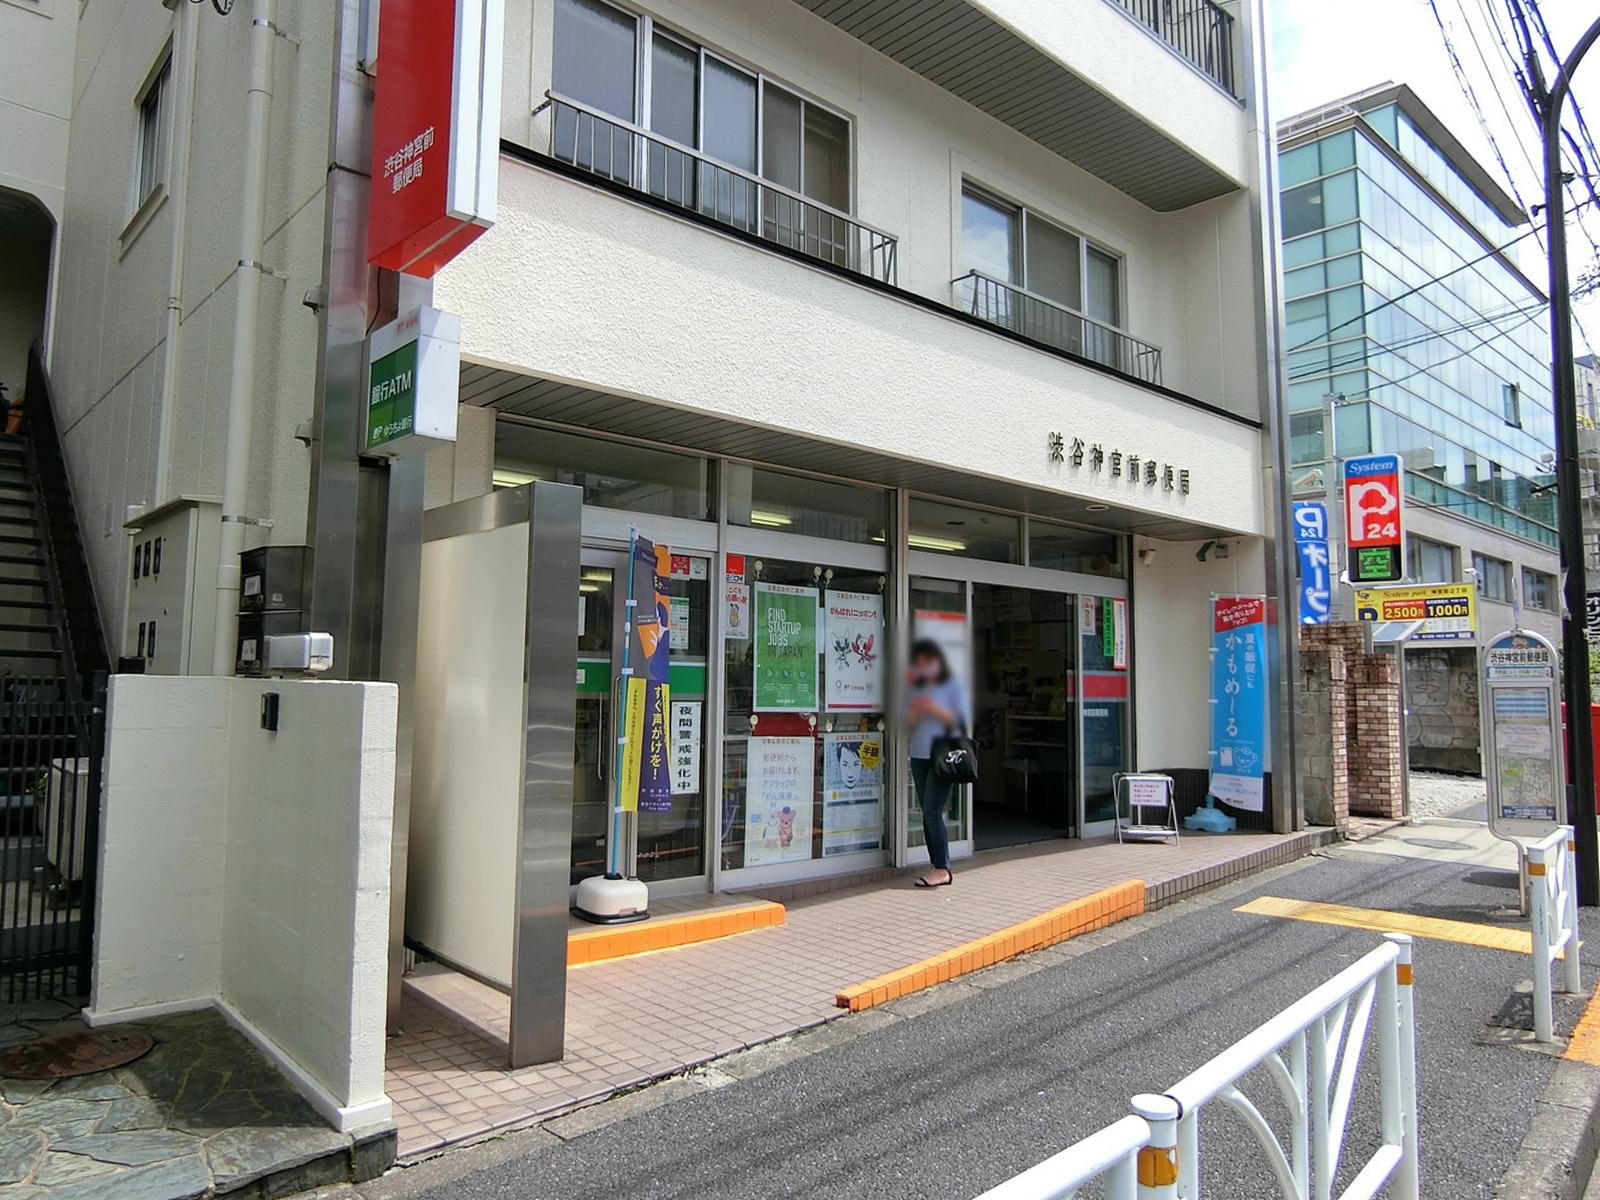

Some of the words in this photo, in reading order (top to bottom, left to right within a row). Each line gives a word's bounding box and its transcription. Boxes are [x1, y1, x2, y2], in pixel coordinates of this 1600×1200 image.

[383, 125, 435, 178] 渋谷神宮前
[392, 156, 423, 194] 郵便局
[371, 369, 412, 406] 銀行ATM
[383, 414, 413, 437] ゆうちょ銀行
[1048, 431, 1191, 496] 渋谷神宮前郵便局
[1348, 460, 1394, 475] System
[1349, 481, 1397, 541] P
[1366, 522, 1397, 539] 24
[767, 607, 786, 621] FIND
[767, 620, 802, 635] STARTUP
[767, 633, 788, 646] JOBS
[768, 645, 776, 658] IN
[778, 646, 804, 659] JAPAN
[1244, 633, 1256, 690] 夏の販促にも
[1490, 651, 1549, 663] 渋谷神宮前郵便局
[677, 706, 694, 790] 夜間警戒強化中
[862, 745, 880, 758] 半額
